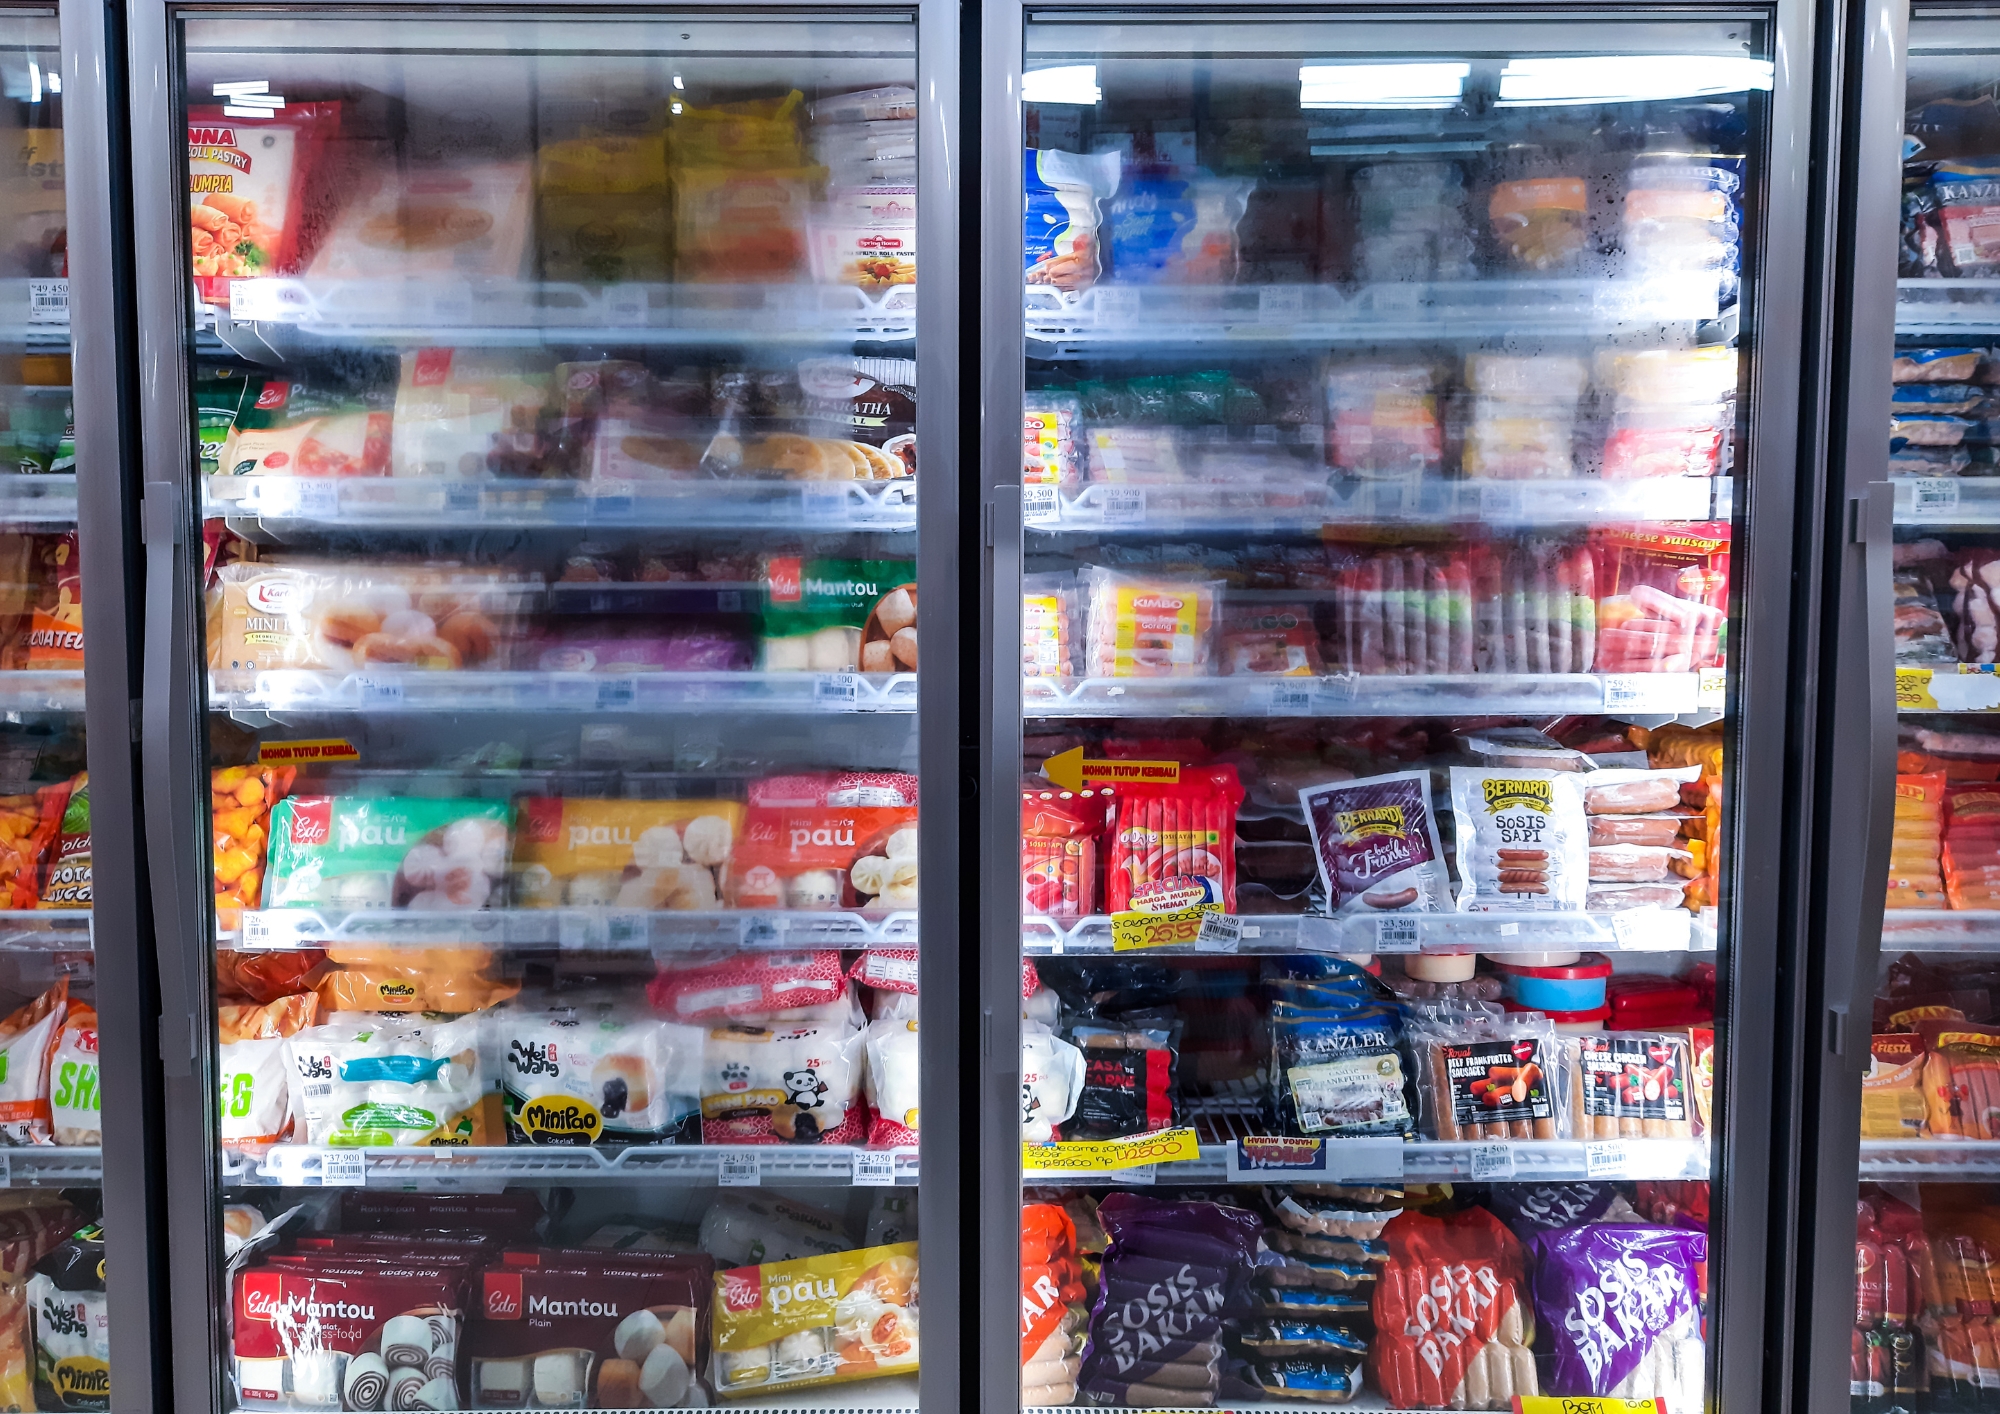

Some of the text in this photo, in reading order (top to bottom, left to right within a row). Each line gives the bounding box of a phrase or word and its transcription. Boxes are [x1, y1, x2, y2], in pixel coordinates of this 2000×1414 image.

[211, 148, 247, 169] PASTRY
[881, 239, 899, 247] Home
[258, 389, 282, 405] Edo
[776, 574, 797, 595] Edo
[806, 578, 878, 596] Mantou
[1133, 598, 1183, 609] KIMBO
[245, 617, 279, 631] MINI
[1141, 622, 1172, 632] Goreng
[261, 747, 292, 760] MOHON
[292, 745, 321, 758] TUTUP
[1082, 764, 1177, 778] MOHON TUTUP KEMBALI
[1481, 778, 1553, 802] BERNARDI
[296, 815, 327, 840] Edo
[528, 814, 556, 838] Edo
[750, 822, 779, 842] Edo
[338, 823, 407, 853] pau
[568, 824, 632, 851] pau
[789, 828, 856, 853] pau
[1501, 829, 1542, 843] SAPI
[1374, 838, 1394, 856] beef
[1349, 840, 1410, 879] Franks
[1133, 875, 1203, 898] SPECIAL
[1137, 889, 1202, 906] HARGA MURAH
[1160, 899, 1188, 911] HEMAT
[1122, 915, 1163, 928] ayam
[1210, 912, 1239, 927] 73,900
[1383, 919, 1415, 929] 83,500
[1299, 1031, 1388, 1053] KANZLER
[1877, 1043, 1912, 1055] FIESTA
[511, 1040, 546, 1062] Wei
[1447, 1046, 1472, 1059] Royal
[1583, 1051, 1647, 1065] CHEESE CHICKEN
[508, 1053, 560, 1078] Wang
[806, 1058, 820, 1068] 25
[1466, 1053, 1513, 1067] FRANKFURTER
[1587, 1061, 1623, 1074] SAUSAGES
[1124, 1066, 1135, 1074] DE
[1451, 1065, 1486, 1079] SAUSAGES
[1023, 1073, 1037, 1083] 25
[746, 1093, 779, 1107] PAO
[527, 1105, 597, 1130] MiniPao
[547, 1136, 575, 1146] Cokelat
[1283, 1137, 1313, 1146] HARGA
[329, 1153, 360, 1163] 37,900
[725, 1153, 755, 1163] 24,750
[860, 1154, 891, 1164] 24,750
[429, 1204, 468, 1213] Mantou
[321, 1267, 365, 1276] Mantou
[416, 1269, 440, 1278] Roti
[768, 1274, 792, 1285] Mini
[729, 1282, 759, 1306] Edo
[769, 1277, 839, 1315] pau
[1564, 1250, 1649, 1347] SOSIS
[43, 1297, 76, 1321] Wei
[289, 1295, 376, 1321] Mantou
[488, 1290, 518, 1314] Edo
[528, 1295, 619, 1317] Mantou
[1104, 1263, 1198, 1345] SOSIS
[43, 1309, 88, 1338] Wang
[528, 1318, 552, 1328] Plain
[1111, 1282, 1226, 1375] BAKAR
[1418, 1265, 1501, 1380] BAKAR
[1578, 1262, 1685, 1388] BAKAR
